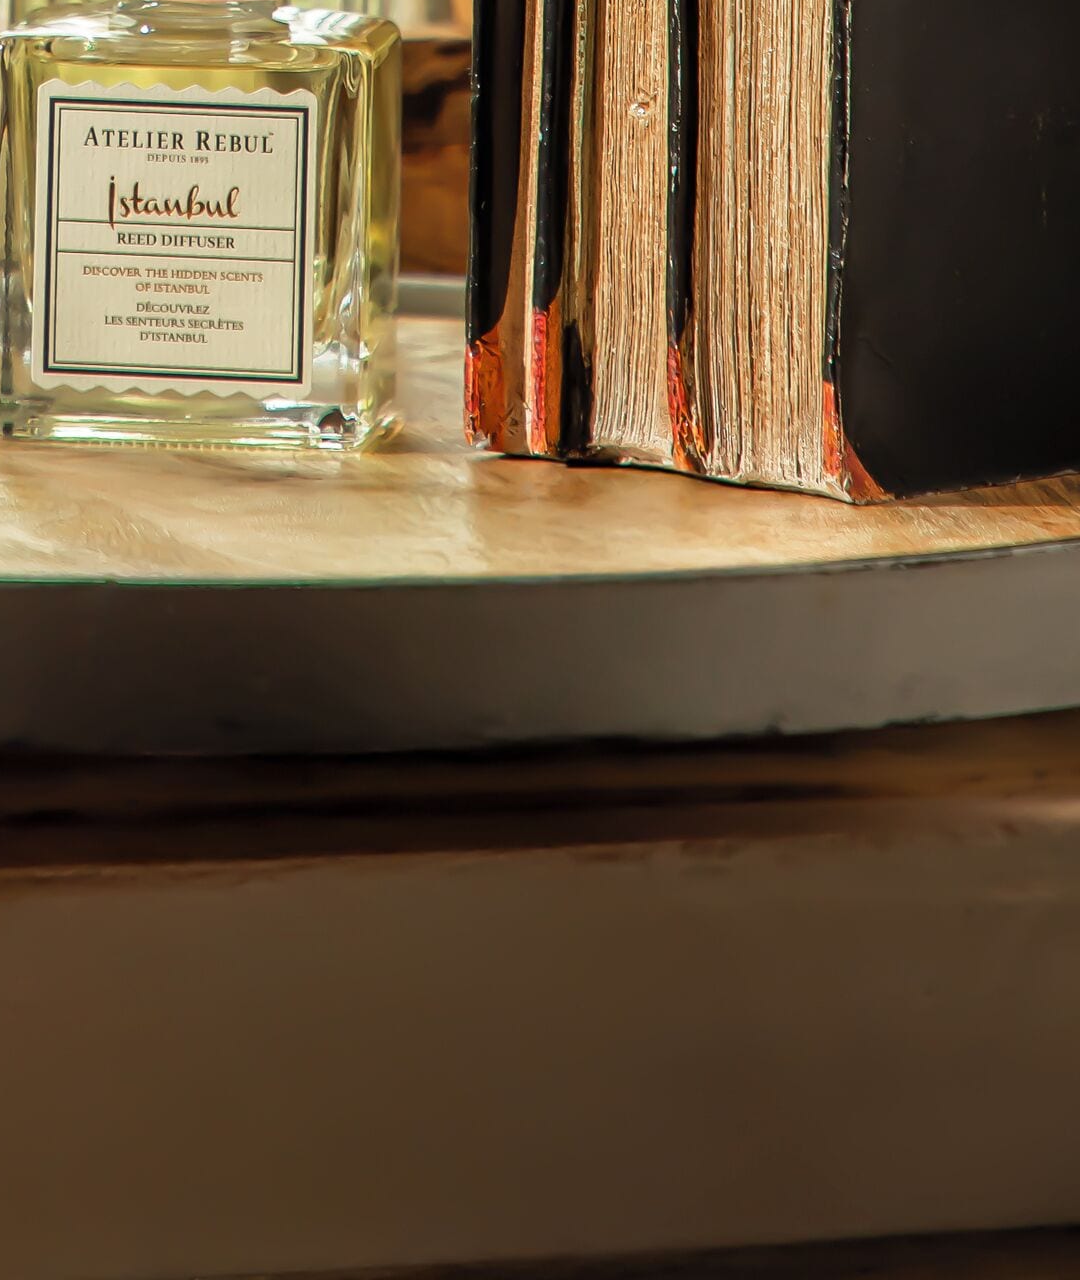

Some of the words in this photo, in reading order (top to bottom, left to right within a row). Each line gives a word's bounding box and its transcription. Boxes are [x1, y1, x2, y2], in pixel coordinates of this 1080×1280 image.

[83, 126, 185, 150] ATELIER
[196, 130, 274, 154] REBUL
[147, 153, 187, 163] DEPUIS
[117, 232, 157, 246] REED
[161, 234, 235, 249] DIFFUSER
[83, 265, 142, 278] DISCOVER
[145, 268, 169, 279] THE
[171, 269, 217, 281] HIDDEN
[220, 271, 264, 283] SCENTS
[135, 283, 151, 292] OF
[154, 283, 211, 295] ISTANBUL
[136, 301, 210, 315] DÉCOUVREZ
[104, 315, 123, 326] LES
[125, 316, 185, 329] SENTEURS
[188, 317, 244, 331] SECRÈTES
[139, 331, 208, 344] D'ISTANBUL
